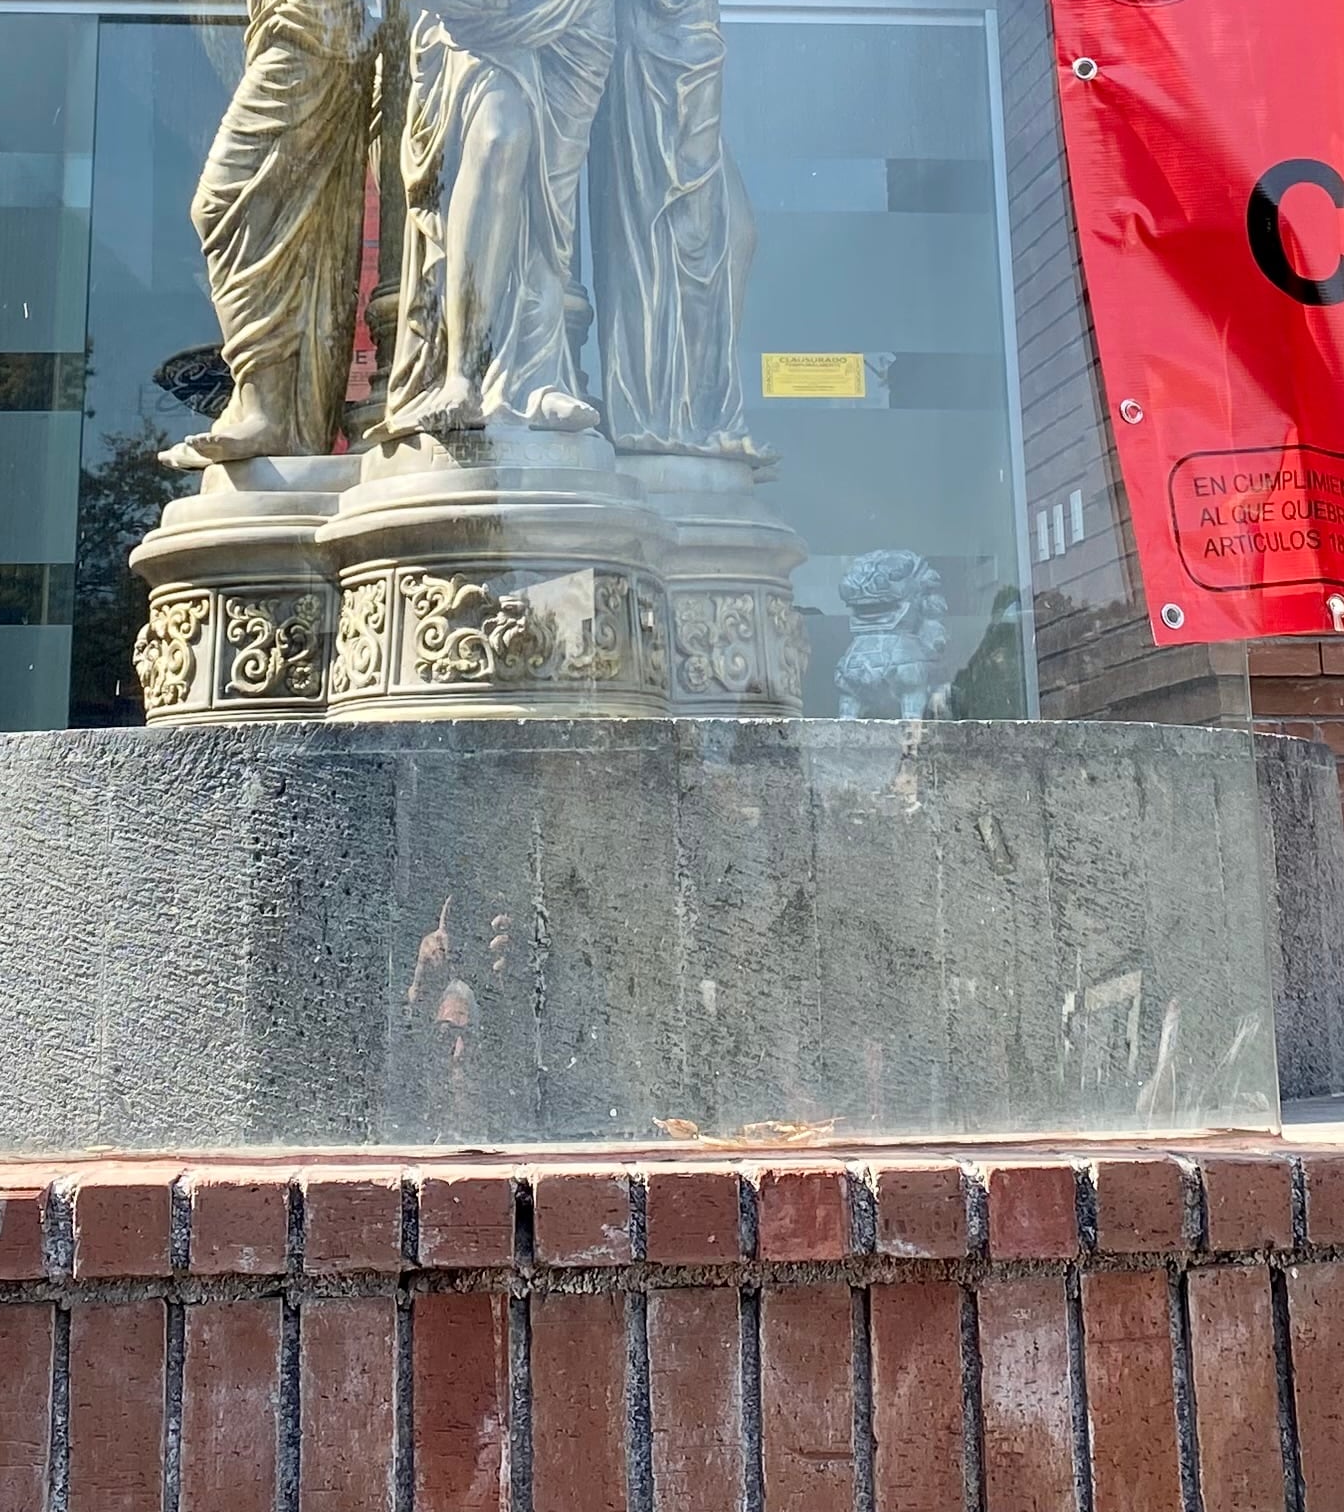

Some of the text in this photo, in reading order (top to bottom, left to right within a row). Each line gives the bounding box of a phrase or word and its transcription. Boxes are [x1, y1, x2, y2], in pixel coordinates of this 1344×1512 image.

[1194, 474, 1227, 497] EN
[1200, 506, 1228, 528] AL
[1232, 501, 1275, 525] QUE
